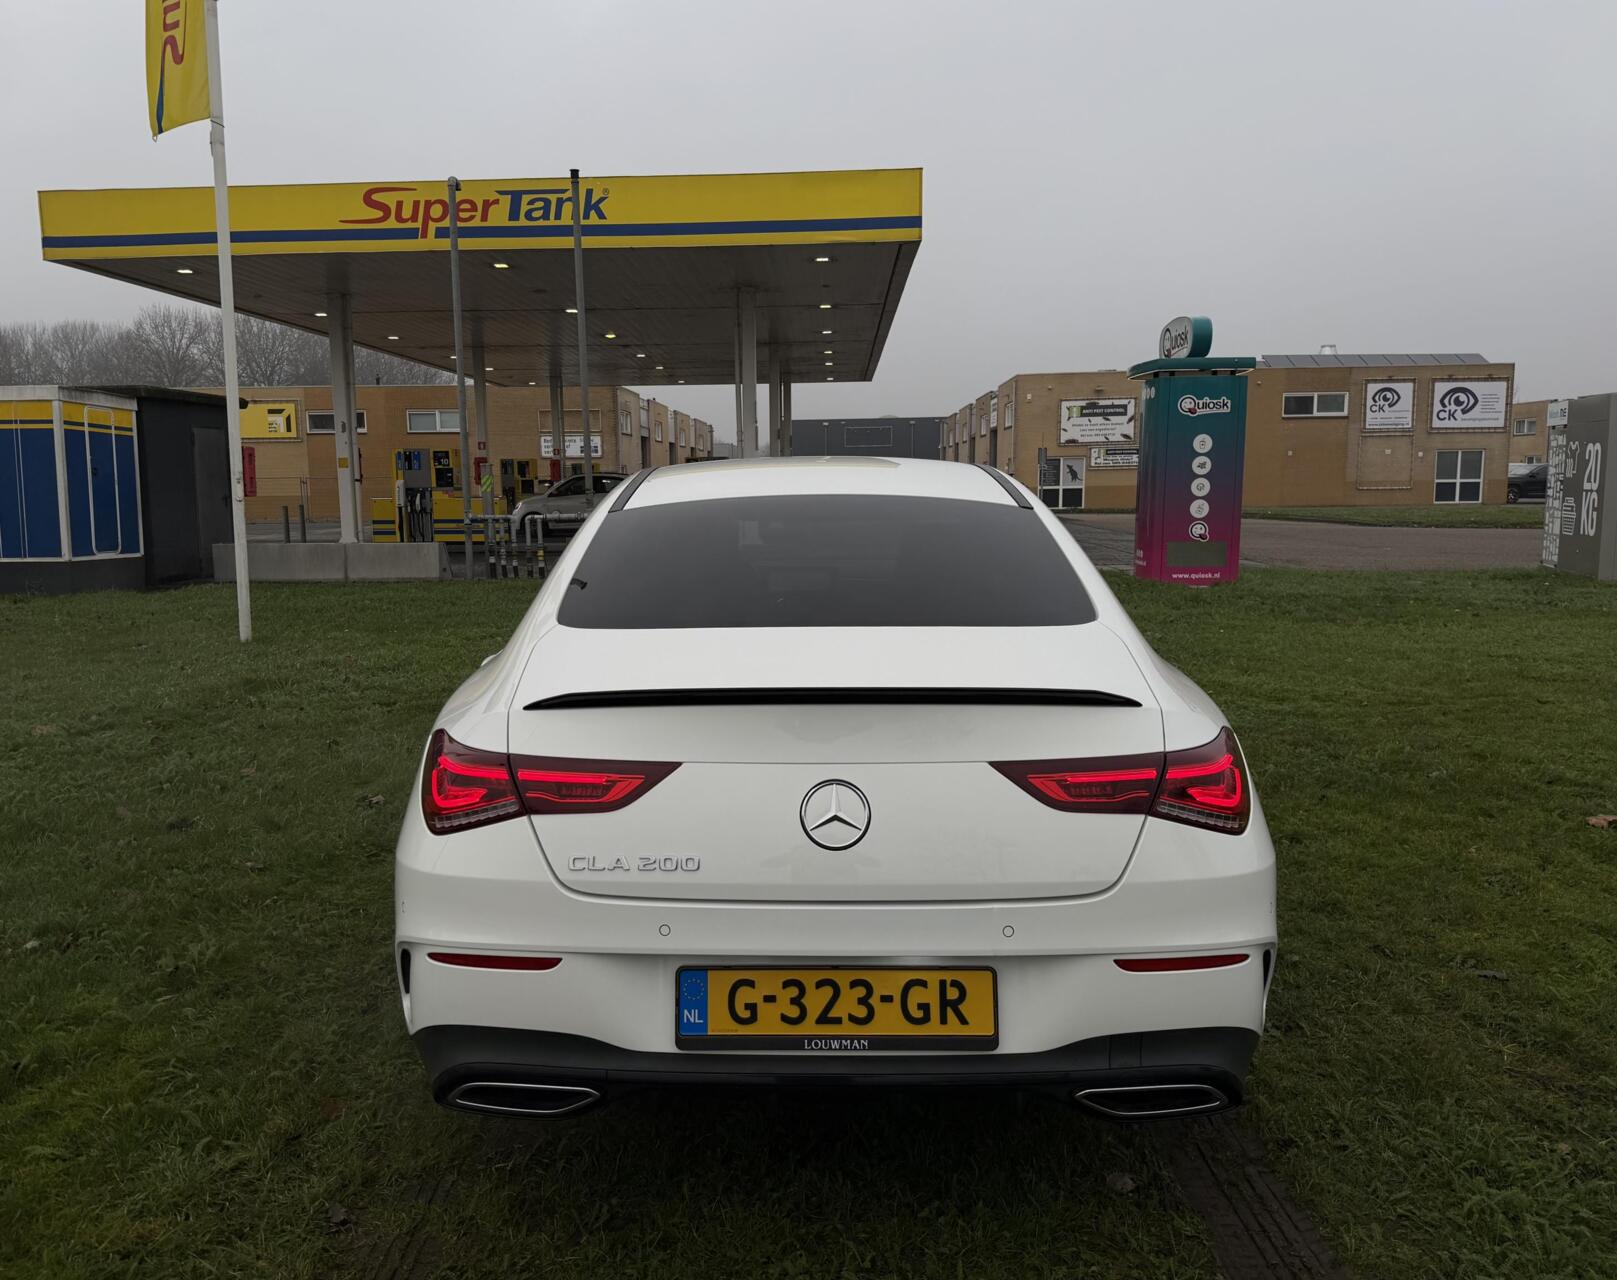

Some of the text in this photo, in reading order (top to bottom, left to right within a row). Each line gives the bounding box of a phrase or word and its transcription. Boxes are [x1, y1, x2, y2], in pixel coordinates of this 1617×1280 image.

[339, 186, 609, 239] SuperTank
[1163, 325, 1189, 358] Quiosk
[1179, 396, 1230, 414] Quiosk
[1370, 404, 1386, 413] CK
[1436, 409, 1458, 421] CK
[1583, 442, 1601, 490] 20
[1580, 491, 1598, 536] KG
[568, 855, 701, 872] CLA 200
[727, 978, 970, 1026] G-323-GR
[683, 1009, 704, 1023] NL
[804, 1039, 869, 1050] LOUWMAN
